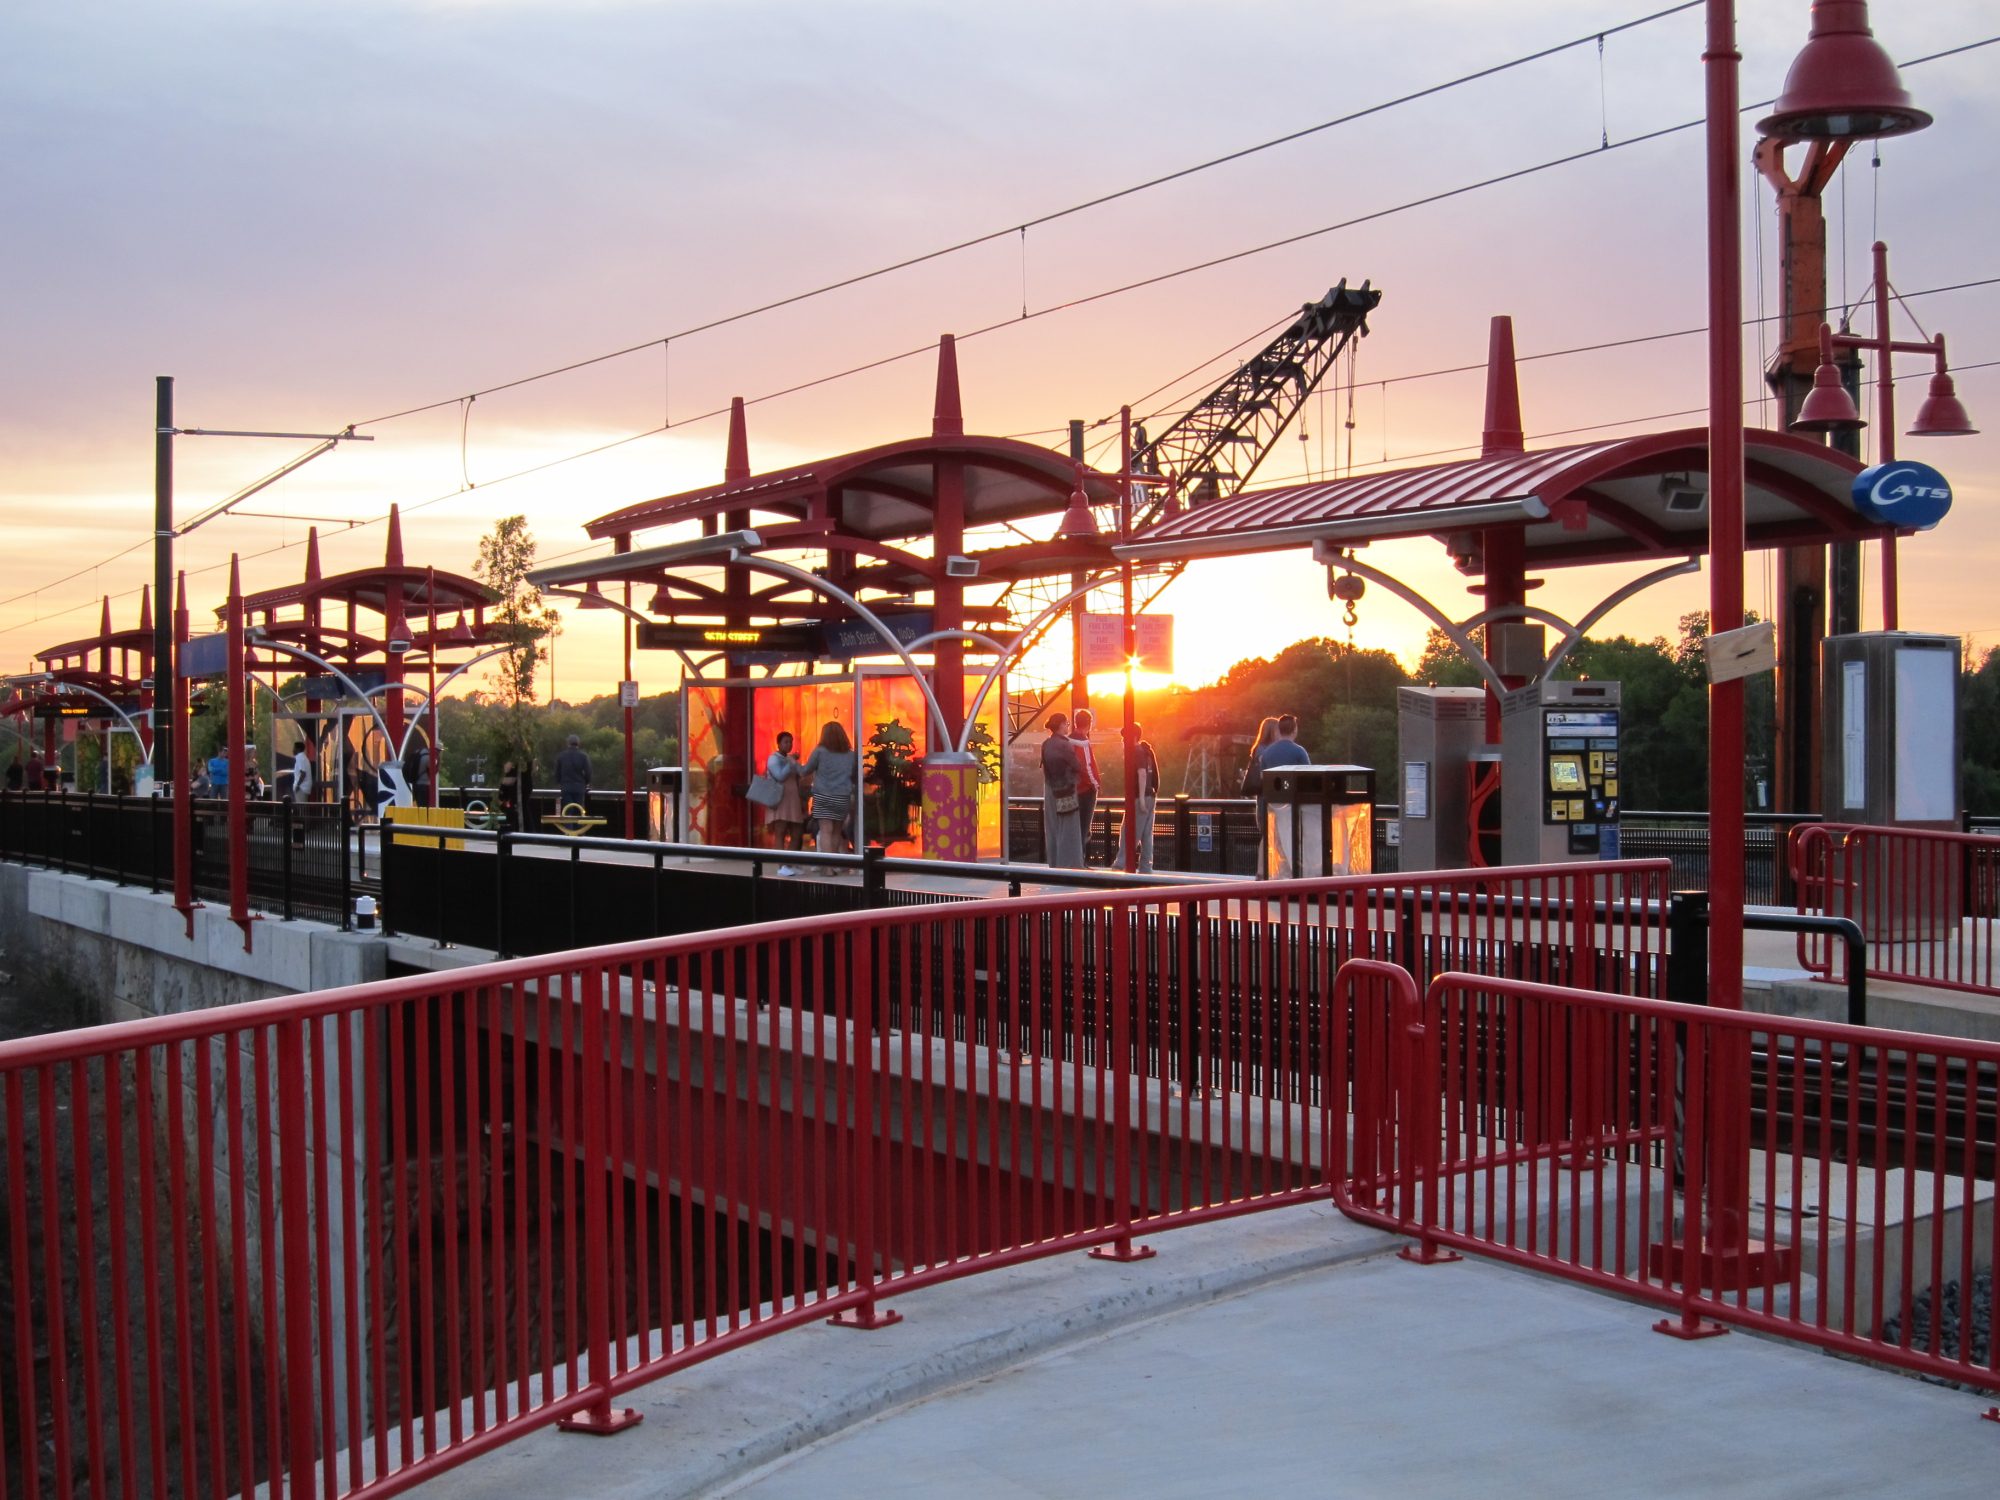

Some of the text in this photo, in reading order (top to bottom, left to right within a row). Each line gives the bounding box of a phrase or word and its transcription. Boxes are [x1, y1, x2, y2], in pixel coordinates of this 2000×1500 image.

[1871, 468, 1950, 505] CATS
[728, 632, 760, 643] STREET
[855, 630, 879, 646] Street
